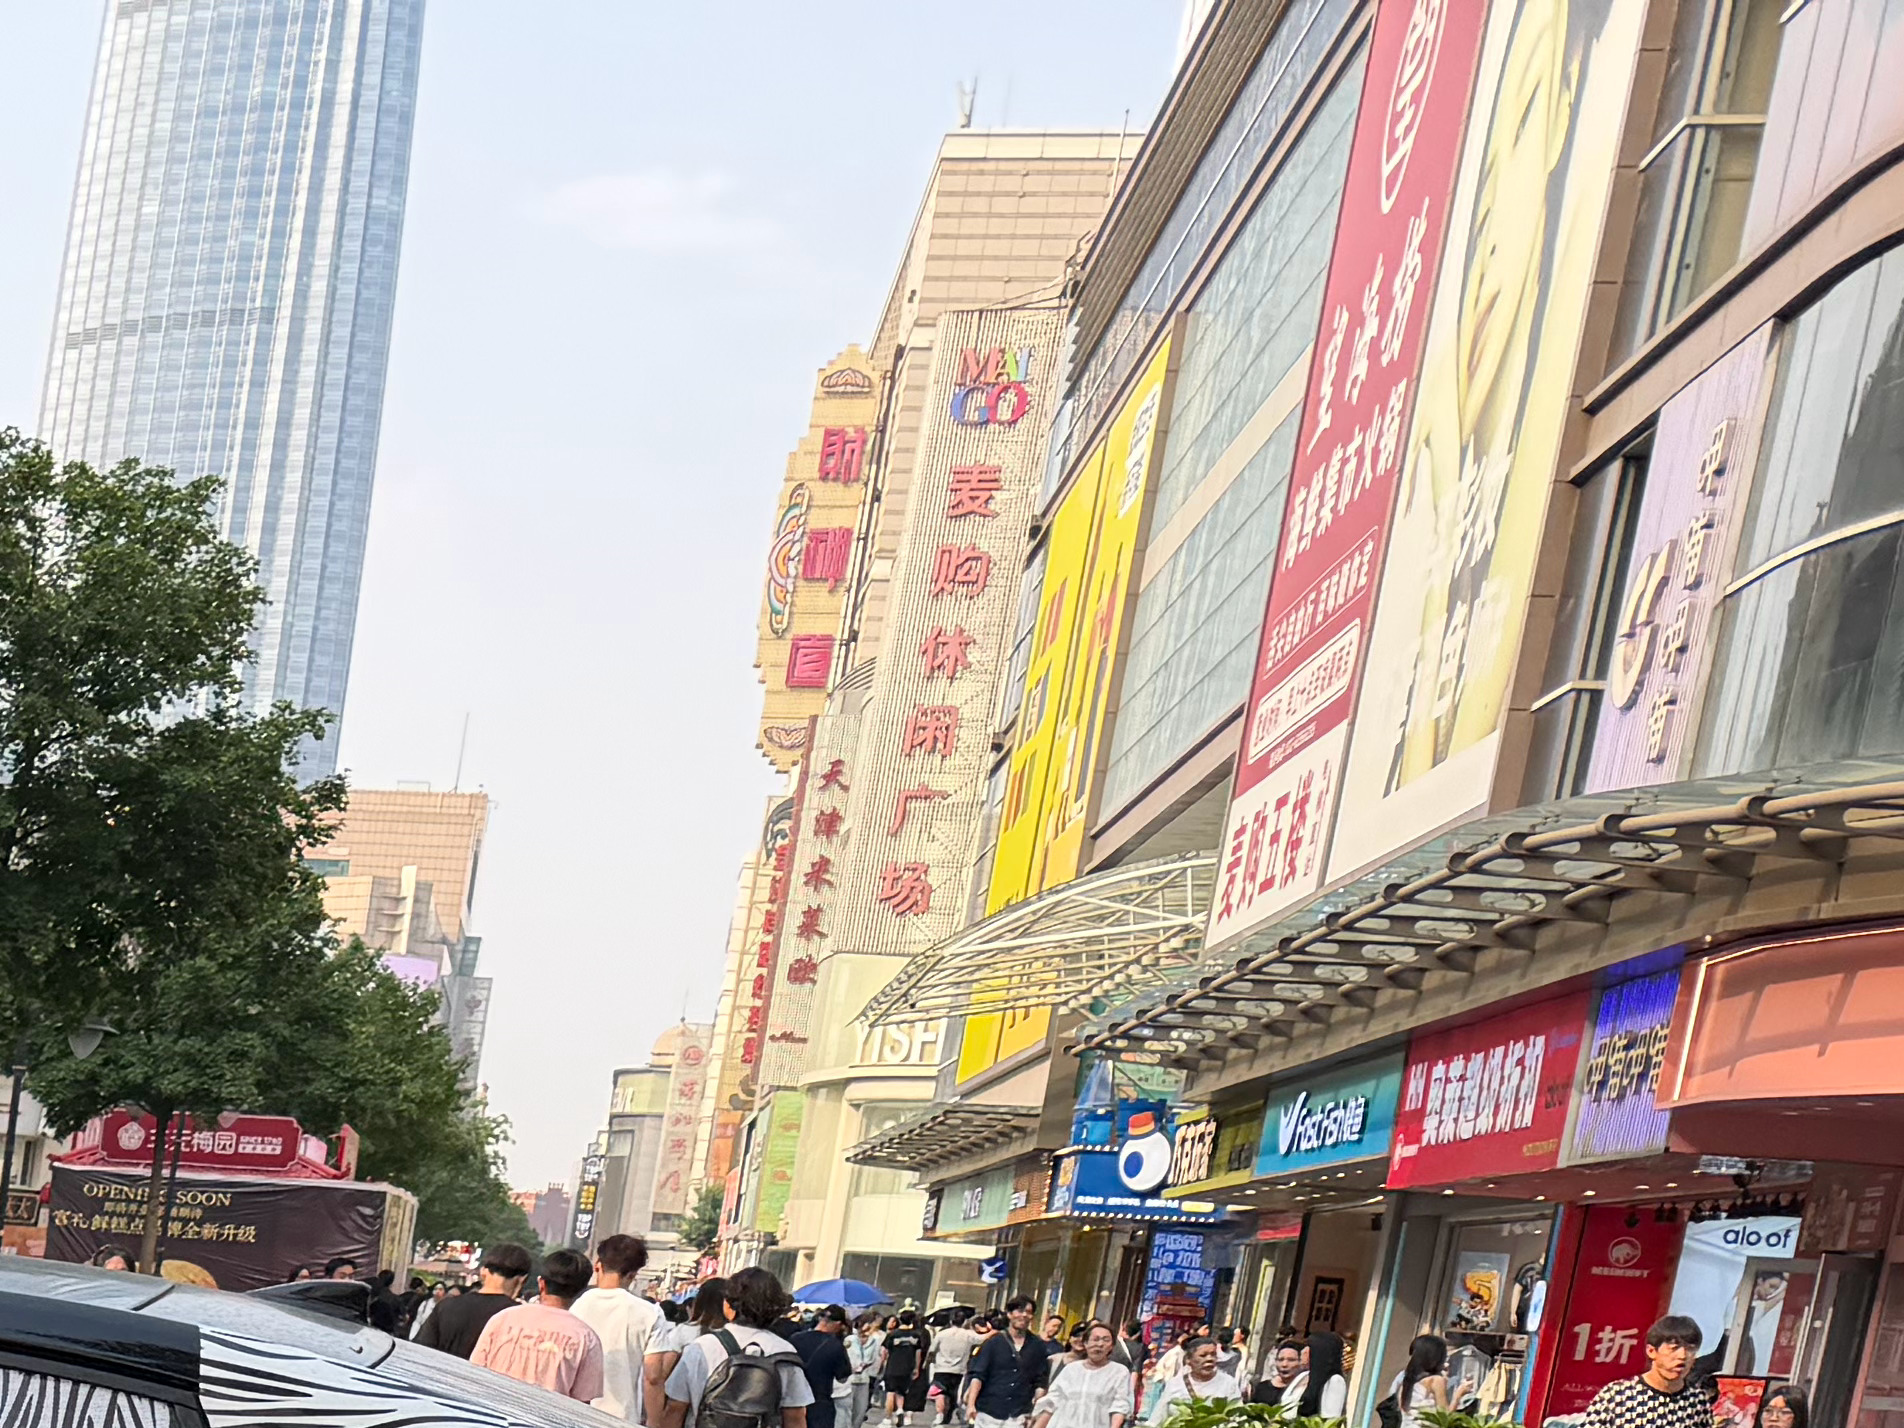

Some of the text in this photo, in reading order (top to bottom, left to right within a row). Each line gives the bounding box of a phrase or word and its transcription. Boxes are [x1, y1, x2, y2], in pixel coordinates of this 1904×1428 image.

[950, 383, 1030, 427] GO
[1282, 378, 1408, 571] 海鲜集市火锅
[879, 462, 1004, 918] 麦购休闲广场
[1214, 768, 1314, 928] 麦购五楼
[1422, 1035, 1546, 1147] 奥莱超级折扣
[175, 1190, 233, 1207] SOON
[1722, 1225, 1793, 1250] aloof
[1571, 1322, 1640, 1365] 1折
